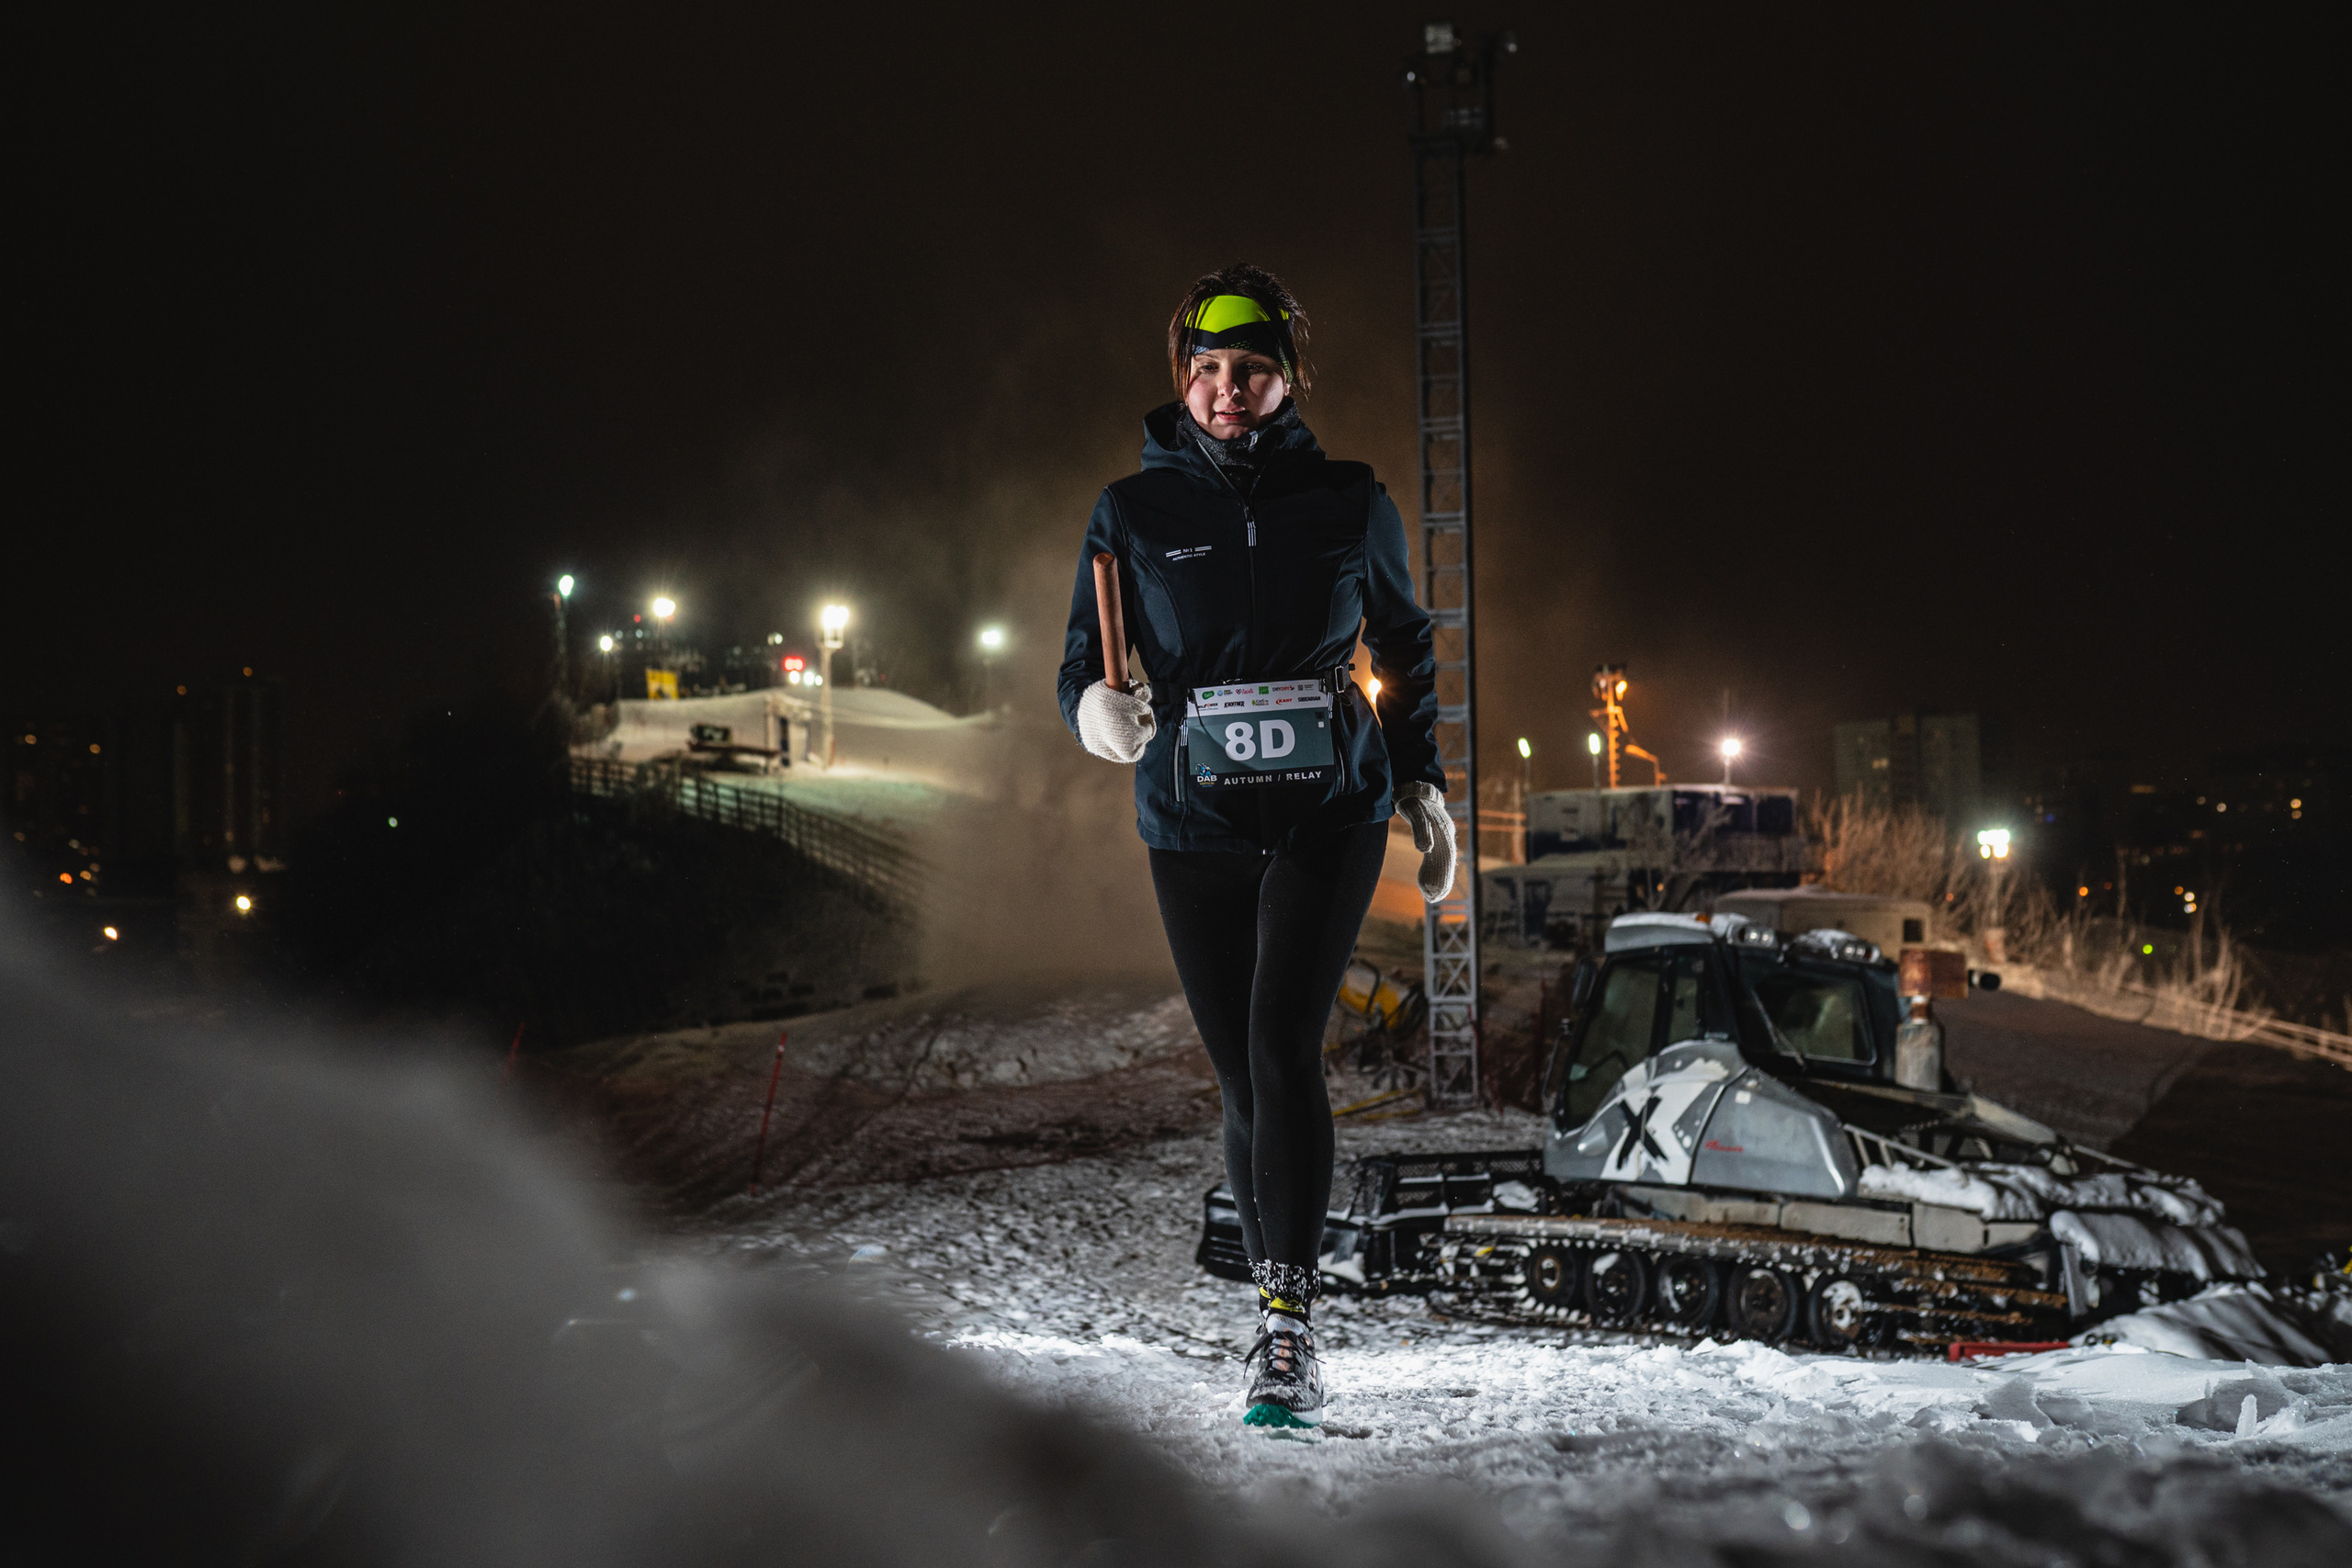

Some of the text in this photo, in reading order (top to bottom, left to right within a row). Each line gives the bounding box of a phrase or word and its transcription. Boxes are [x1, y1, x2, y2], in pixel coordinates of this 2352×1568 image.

[1225, 719, 1295, 761] 8D
[1197, 774, 1217, 783] DAB
[1224, 773, 1272, 785] AUTUMN
[1286, 770, 1322, 780] RELAY
